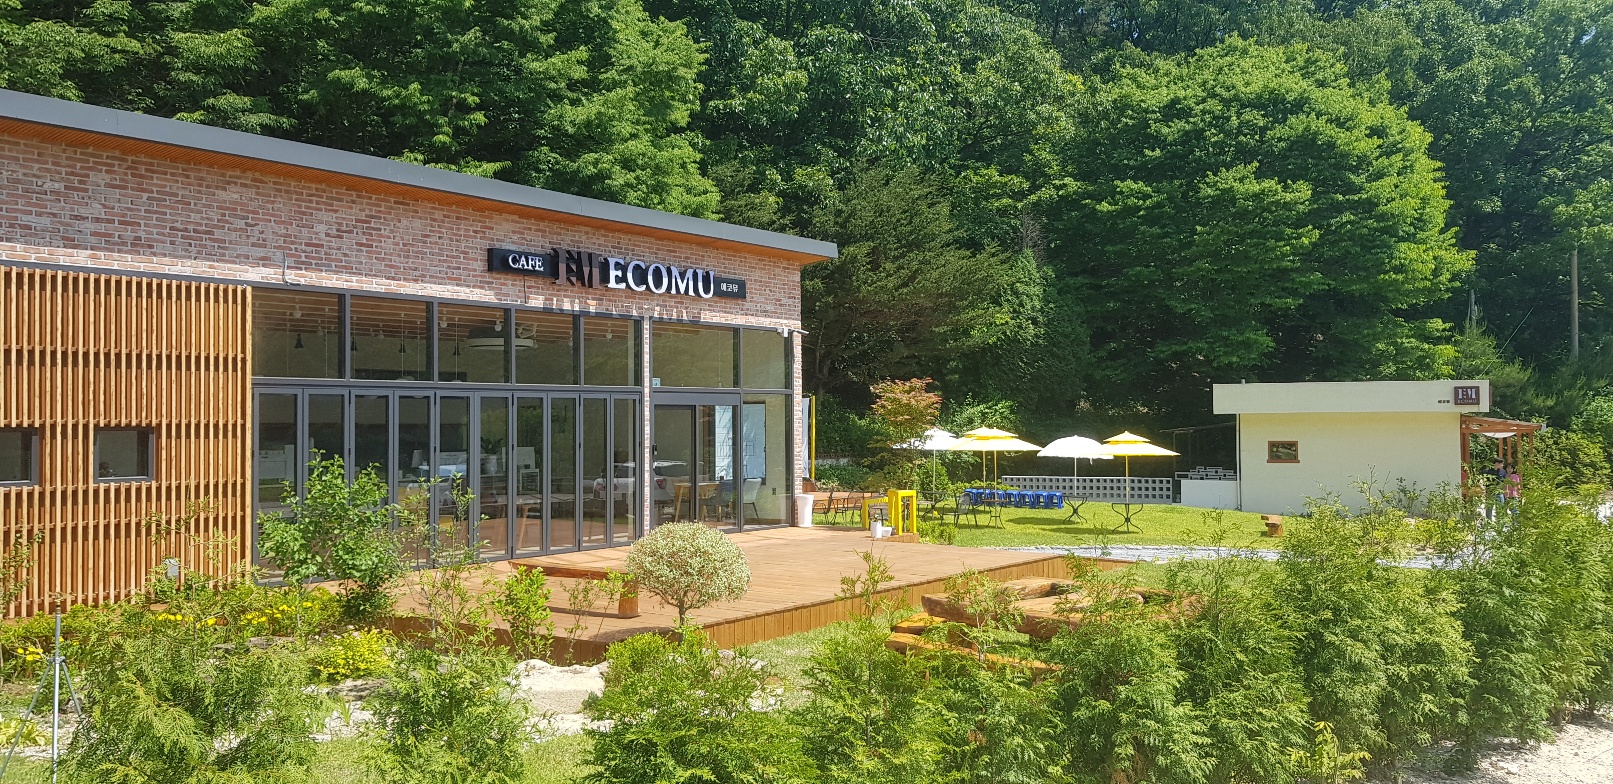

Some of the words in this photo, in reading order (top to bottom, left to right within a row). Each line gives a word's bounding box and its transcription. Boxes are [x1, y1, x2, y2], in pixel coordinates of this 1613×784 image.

[509, 254, 544, 271] CAFE
[607, 257, 715, 299] ECOMU
[720, 283, 738, 293] 에코뮤
